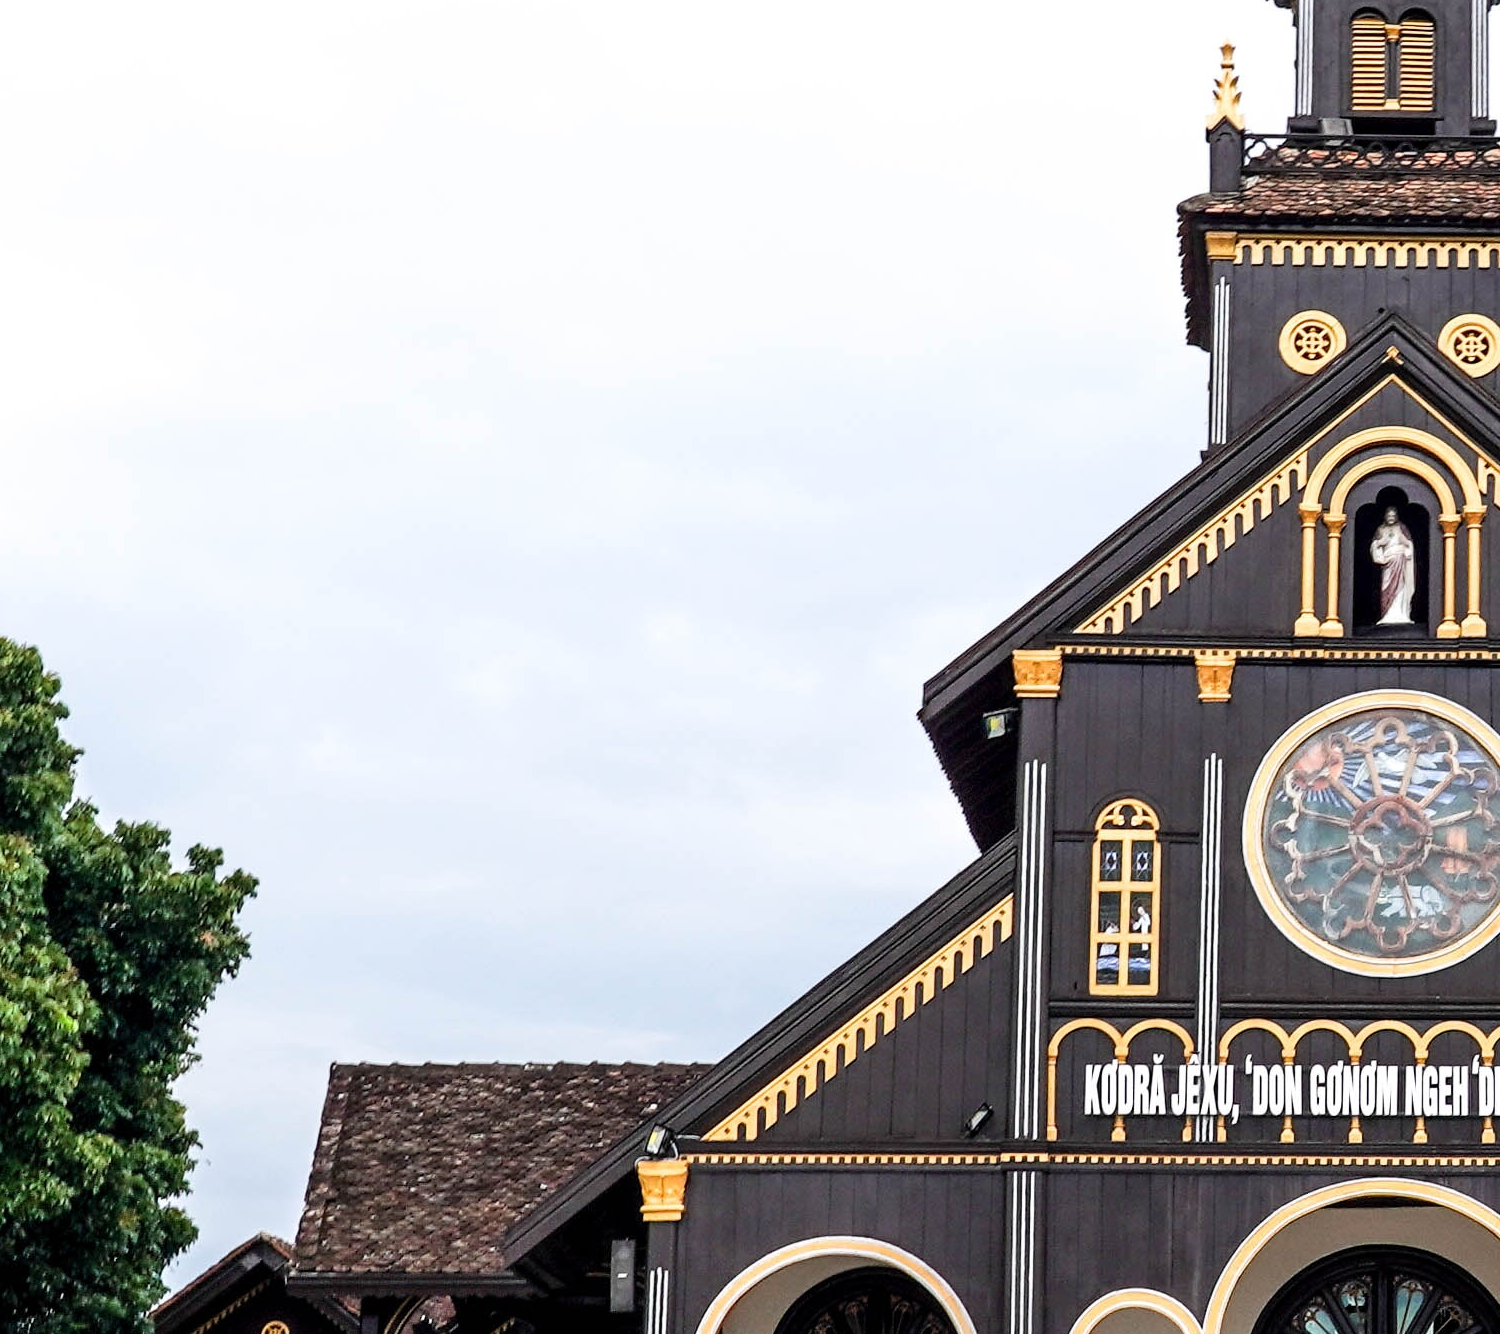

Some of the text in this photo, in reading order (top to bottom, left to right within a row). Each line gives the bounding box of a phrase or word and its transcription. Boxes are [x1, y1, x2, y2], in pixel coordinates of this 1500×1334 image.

[1084, 1053, 1167, 1116] KƠDRĂ
[1171, 1052, 1240, 1126] JÊXU,
[1309, 1060, 1399, 1117] GƠNƠM
[1404, 1065, 1469, 1117] NGEH
